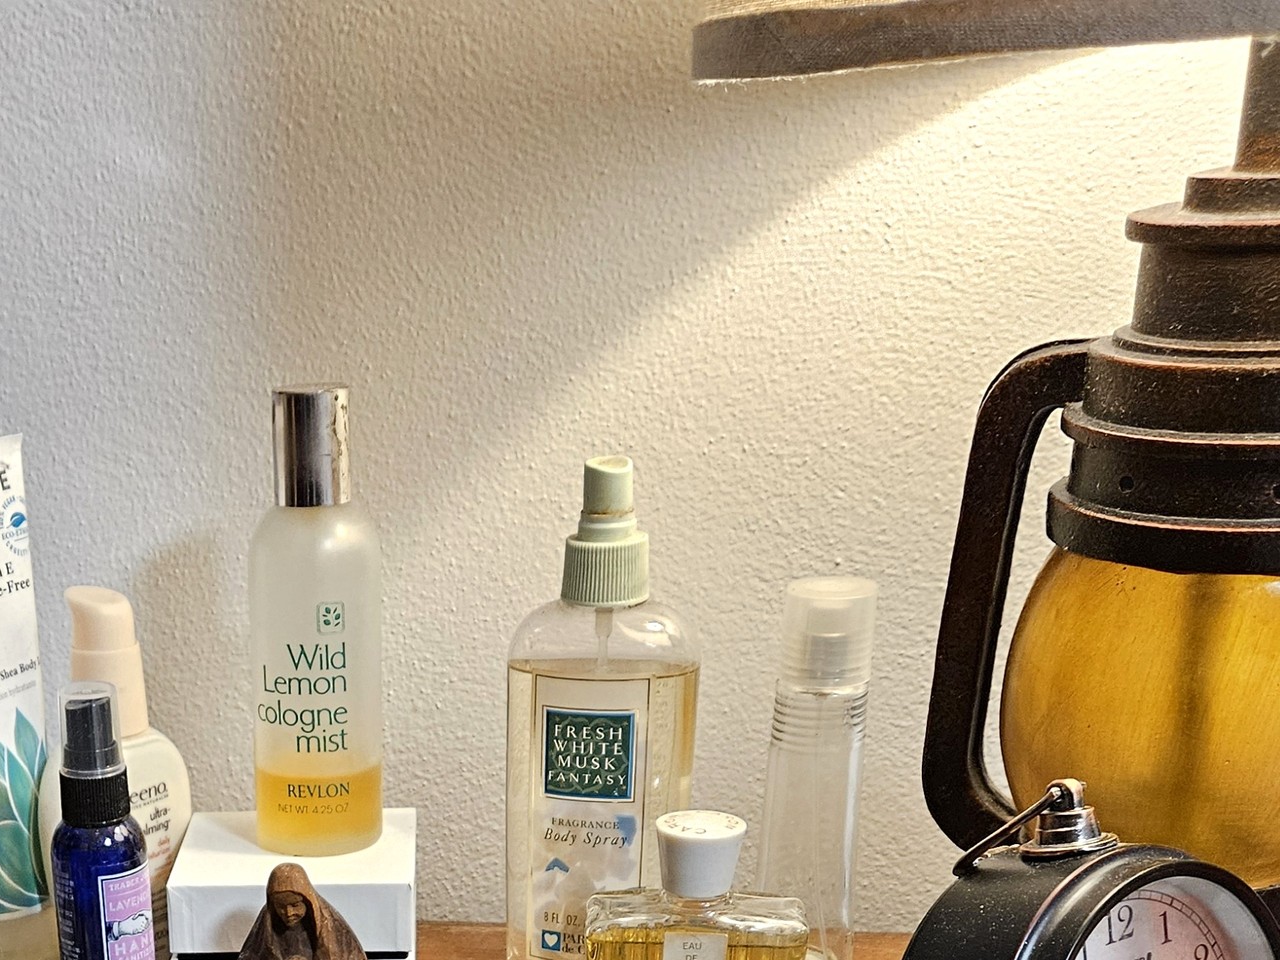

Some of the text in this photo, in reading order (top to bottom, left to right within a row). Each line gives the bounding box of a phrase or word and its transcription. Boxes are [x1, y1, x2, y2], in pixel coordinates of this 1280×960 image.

[5, 561, 15, 576] E
[286, 642, 347, 671] Wild
[0, 668, 19, 681] Shea
[19, 658, 37, 673] Body
[263, 664, 347, 696] Lemon
[257, 700, 348, 734] cologne
[296, 728, 348, 753] mist
[554, 724, 623, 740] FRESH
[553, 739, 624, 756] WHITE
[558, 755, 616, 771] MUSK
[548, 770, 627, 786] FANTASY
[287, 781, 351, 799] REVLON
[278, 803, 293, 814] NET
[294, 805, 309, 815] WT
[551, 816, 620, 831] FRAGRANCE
[543, 828, 628, 849] Body Spray
[543, 911, 549, 922] 8
[1105, 904, 1135, 946] 12
[1159, 910, 1173, 946] 1
[682, 942, 703, 951] EAU
